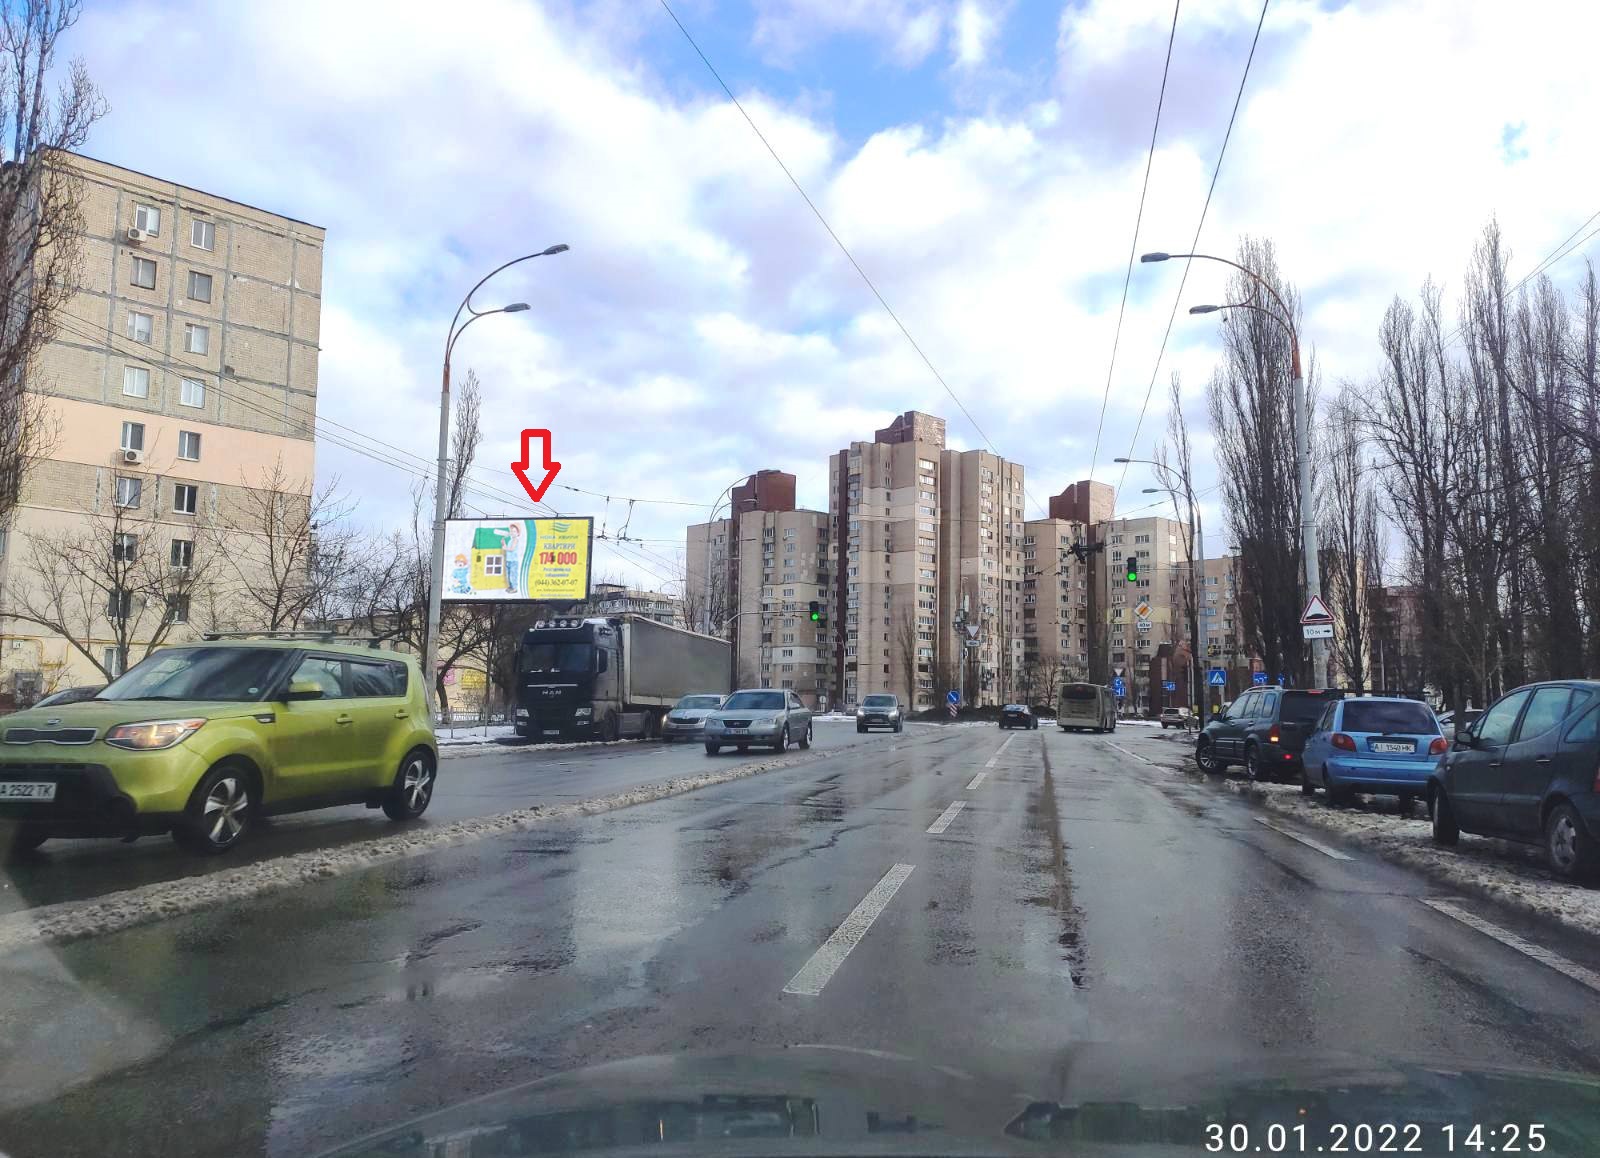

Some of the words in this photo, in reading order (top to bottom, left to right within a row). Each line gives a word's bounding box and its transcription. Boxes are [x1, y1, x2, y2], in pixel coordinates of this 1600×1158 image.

[557, 551, 577, 565] 000
[9, 784, 33, 797] 2522
[37, 784, 53, 797] TK
